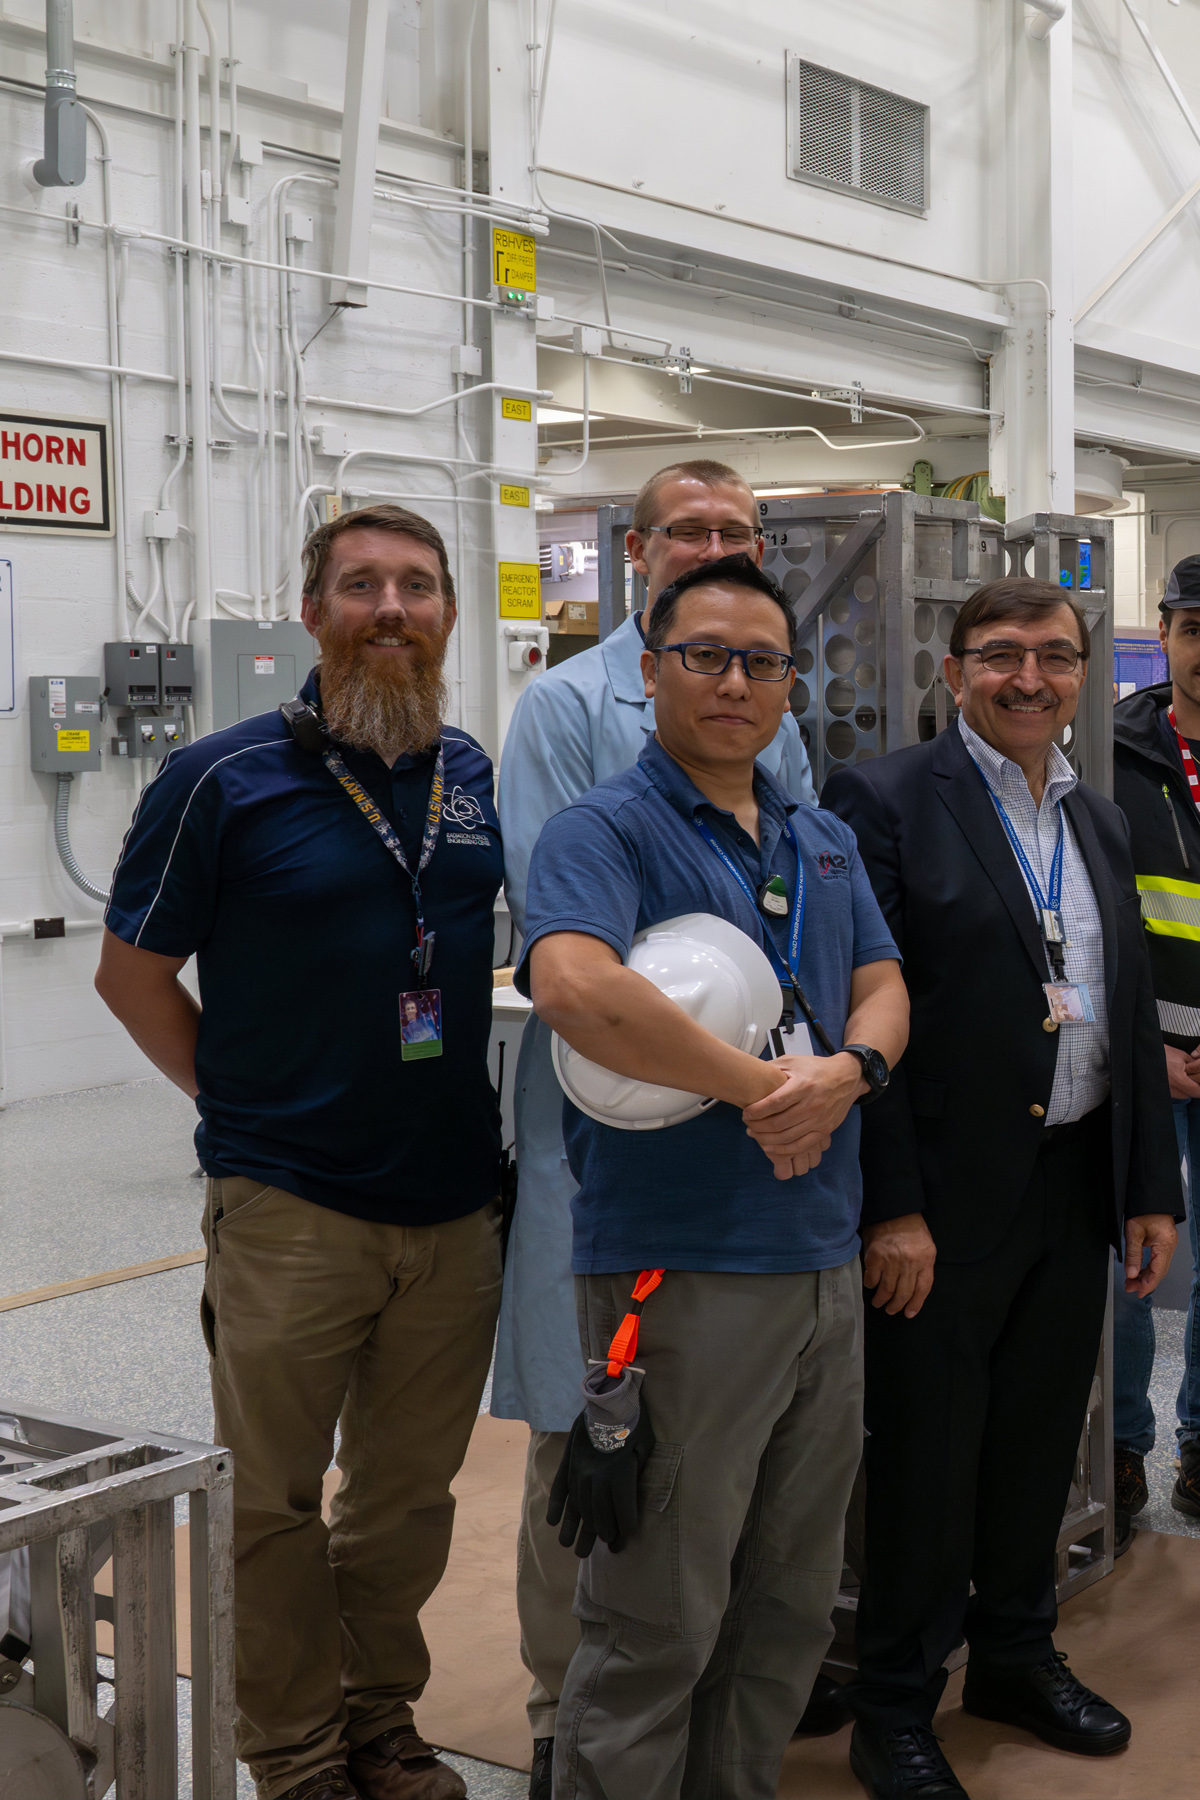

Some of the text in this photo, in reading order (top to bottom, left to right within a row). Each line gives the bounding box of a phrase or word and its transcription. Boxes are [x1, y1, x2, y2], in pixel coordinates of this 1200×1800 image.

[495, 232, 534, 253] RBHVES
[511, 268, 533, 282] DAMPER
[506, 403, 527, 415] EAST
[1, 430, 86, 467] HORN
[504, 489, 526, 502] EAST
[501, 573, 537, 584] EMERGENCY
[502, 585, 537, 596] REACTOR
[507, 598, 534, 608] SCRAM
